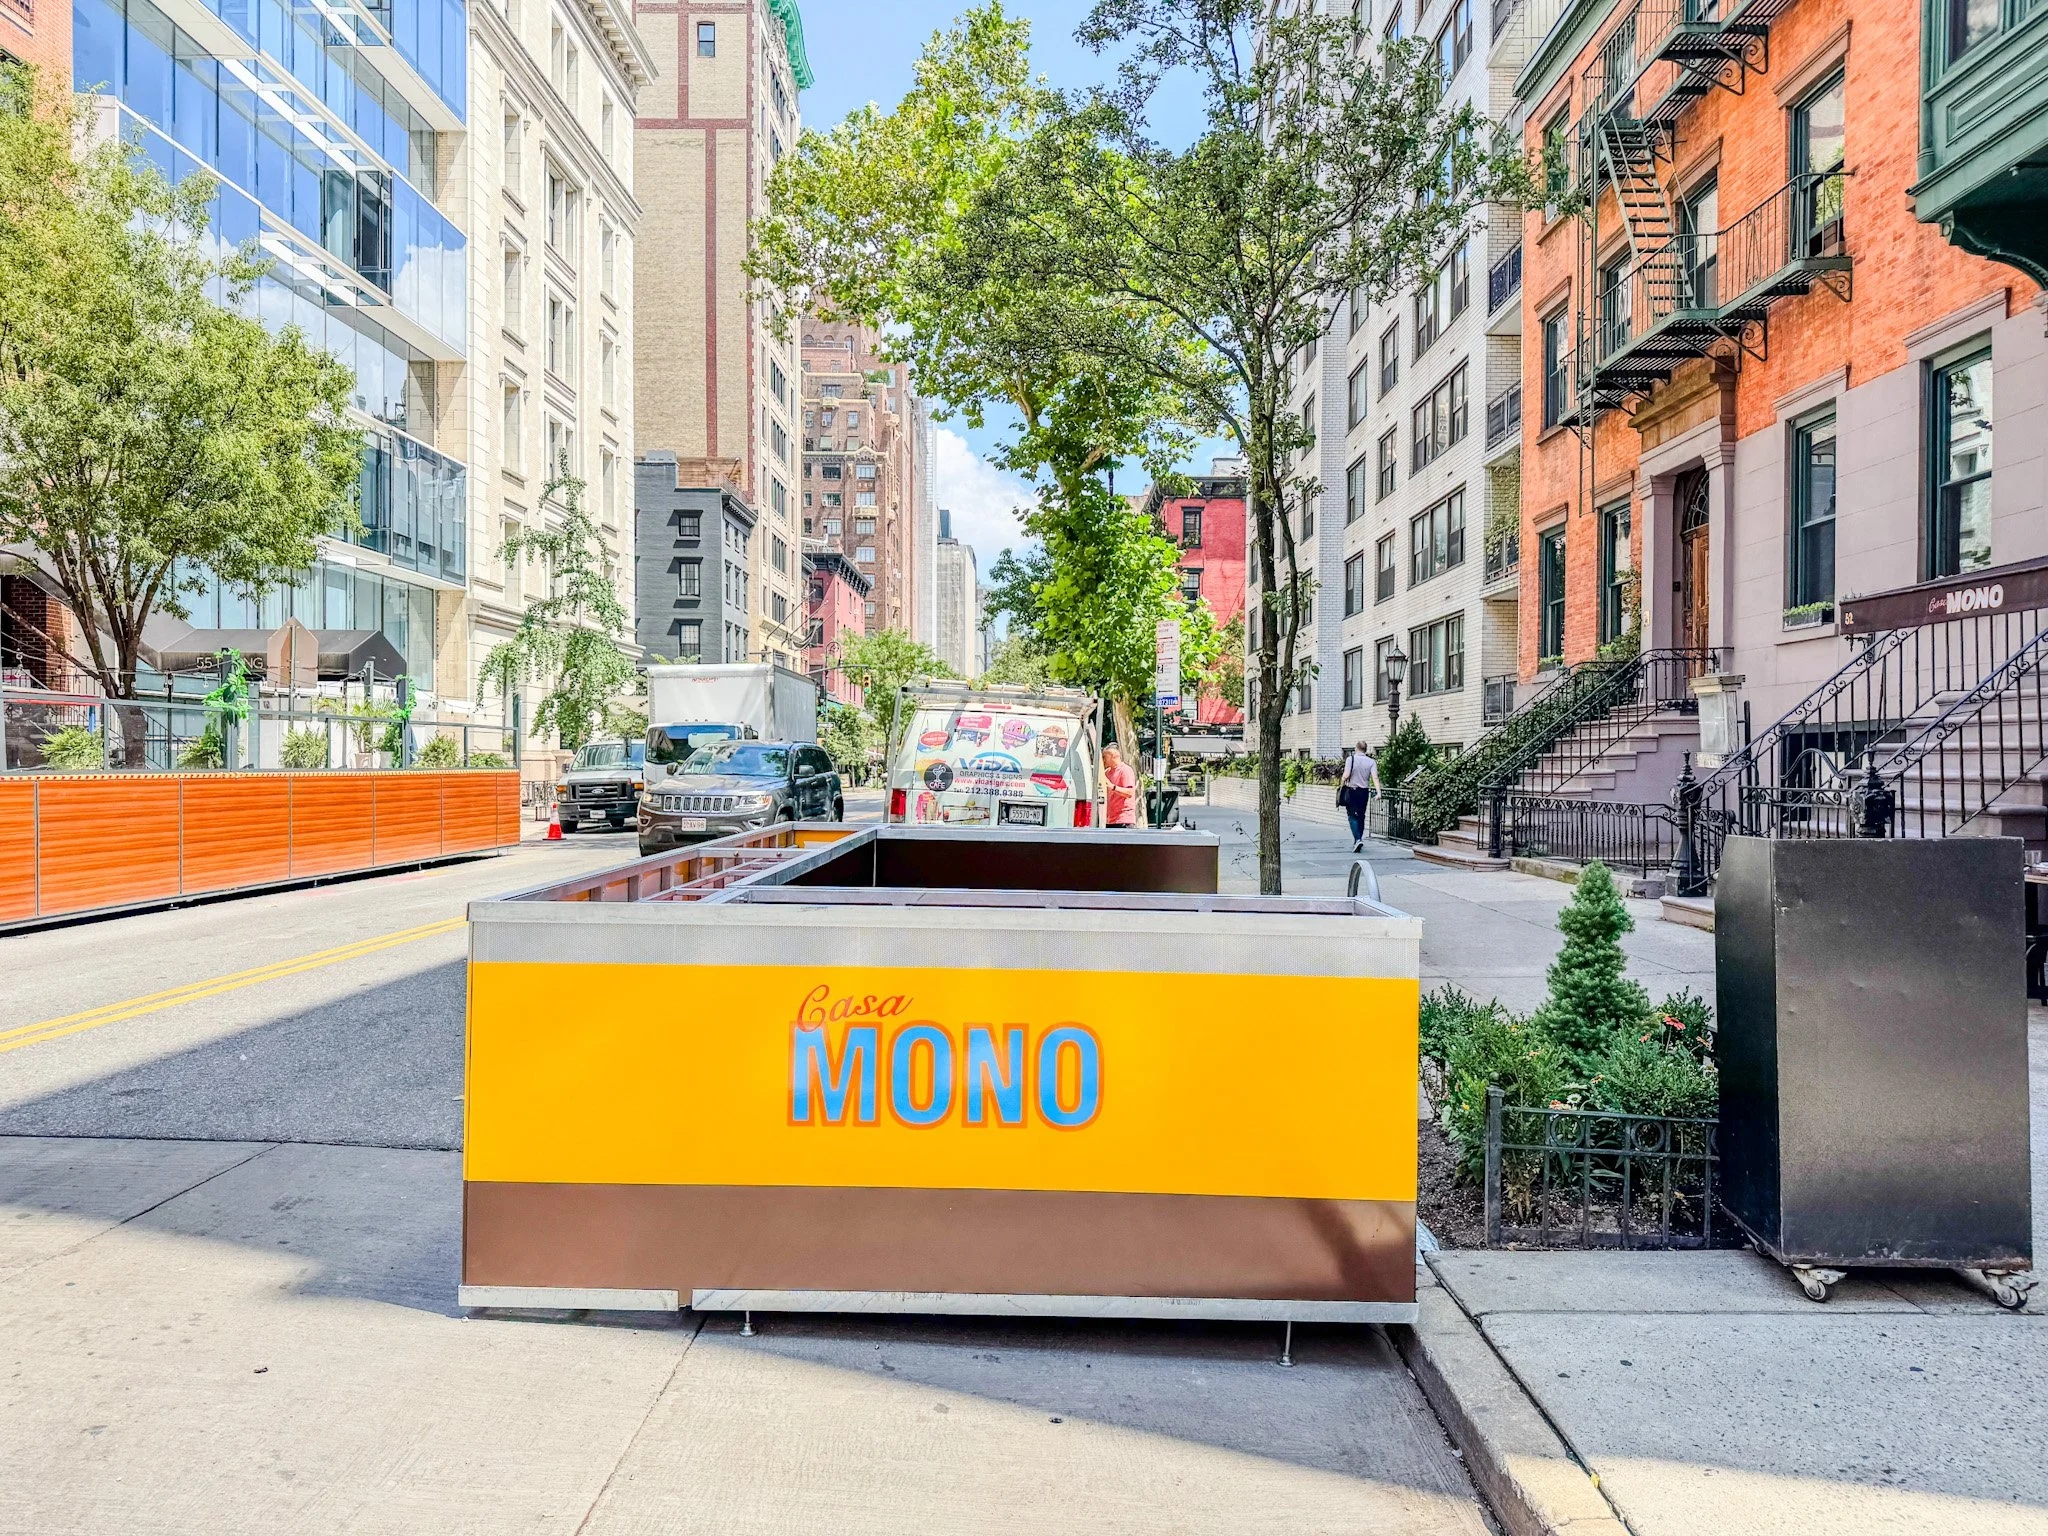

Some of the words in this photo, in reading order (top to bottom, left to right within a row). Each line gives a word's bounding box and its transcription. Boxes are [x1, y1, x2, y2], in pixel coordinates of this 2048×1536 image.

[1946, 584, 2004, 614] MONO
[1844, 612, 1854, 625] 52
[196, 656, 212, 669] 55
[954, 778, 1026, 787] www.vidasigns.com
[797, 984, 914, 1032] Casa
[787, 1020, 1105, 1132] MONO
